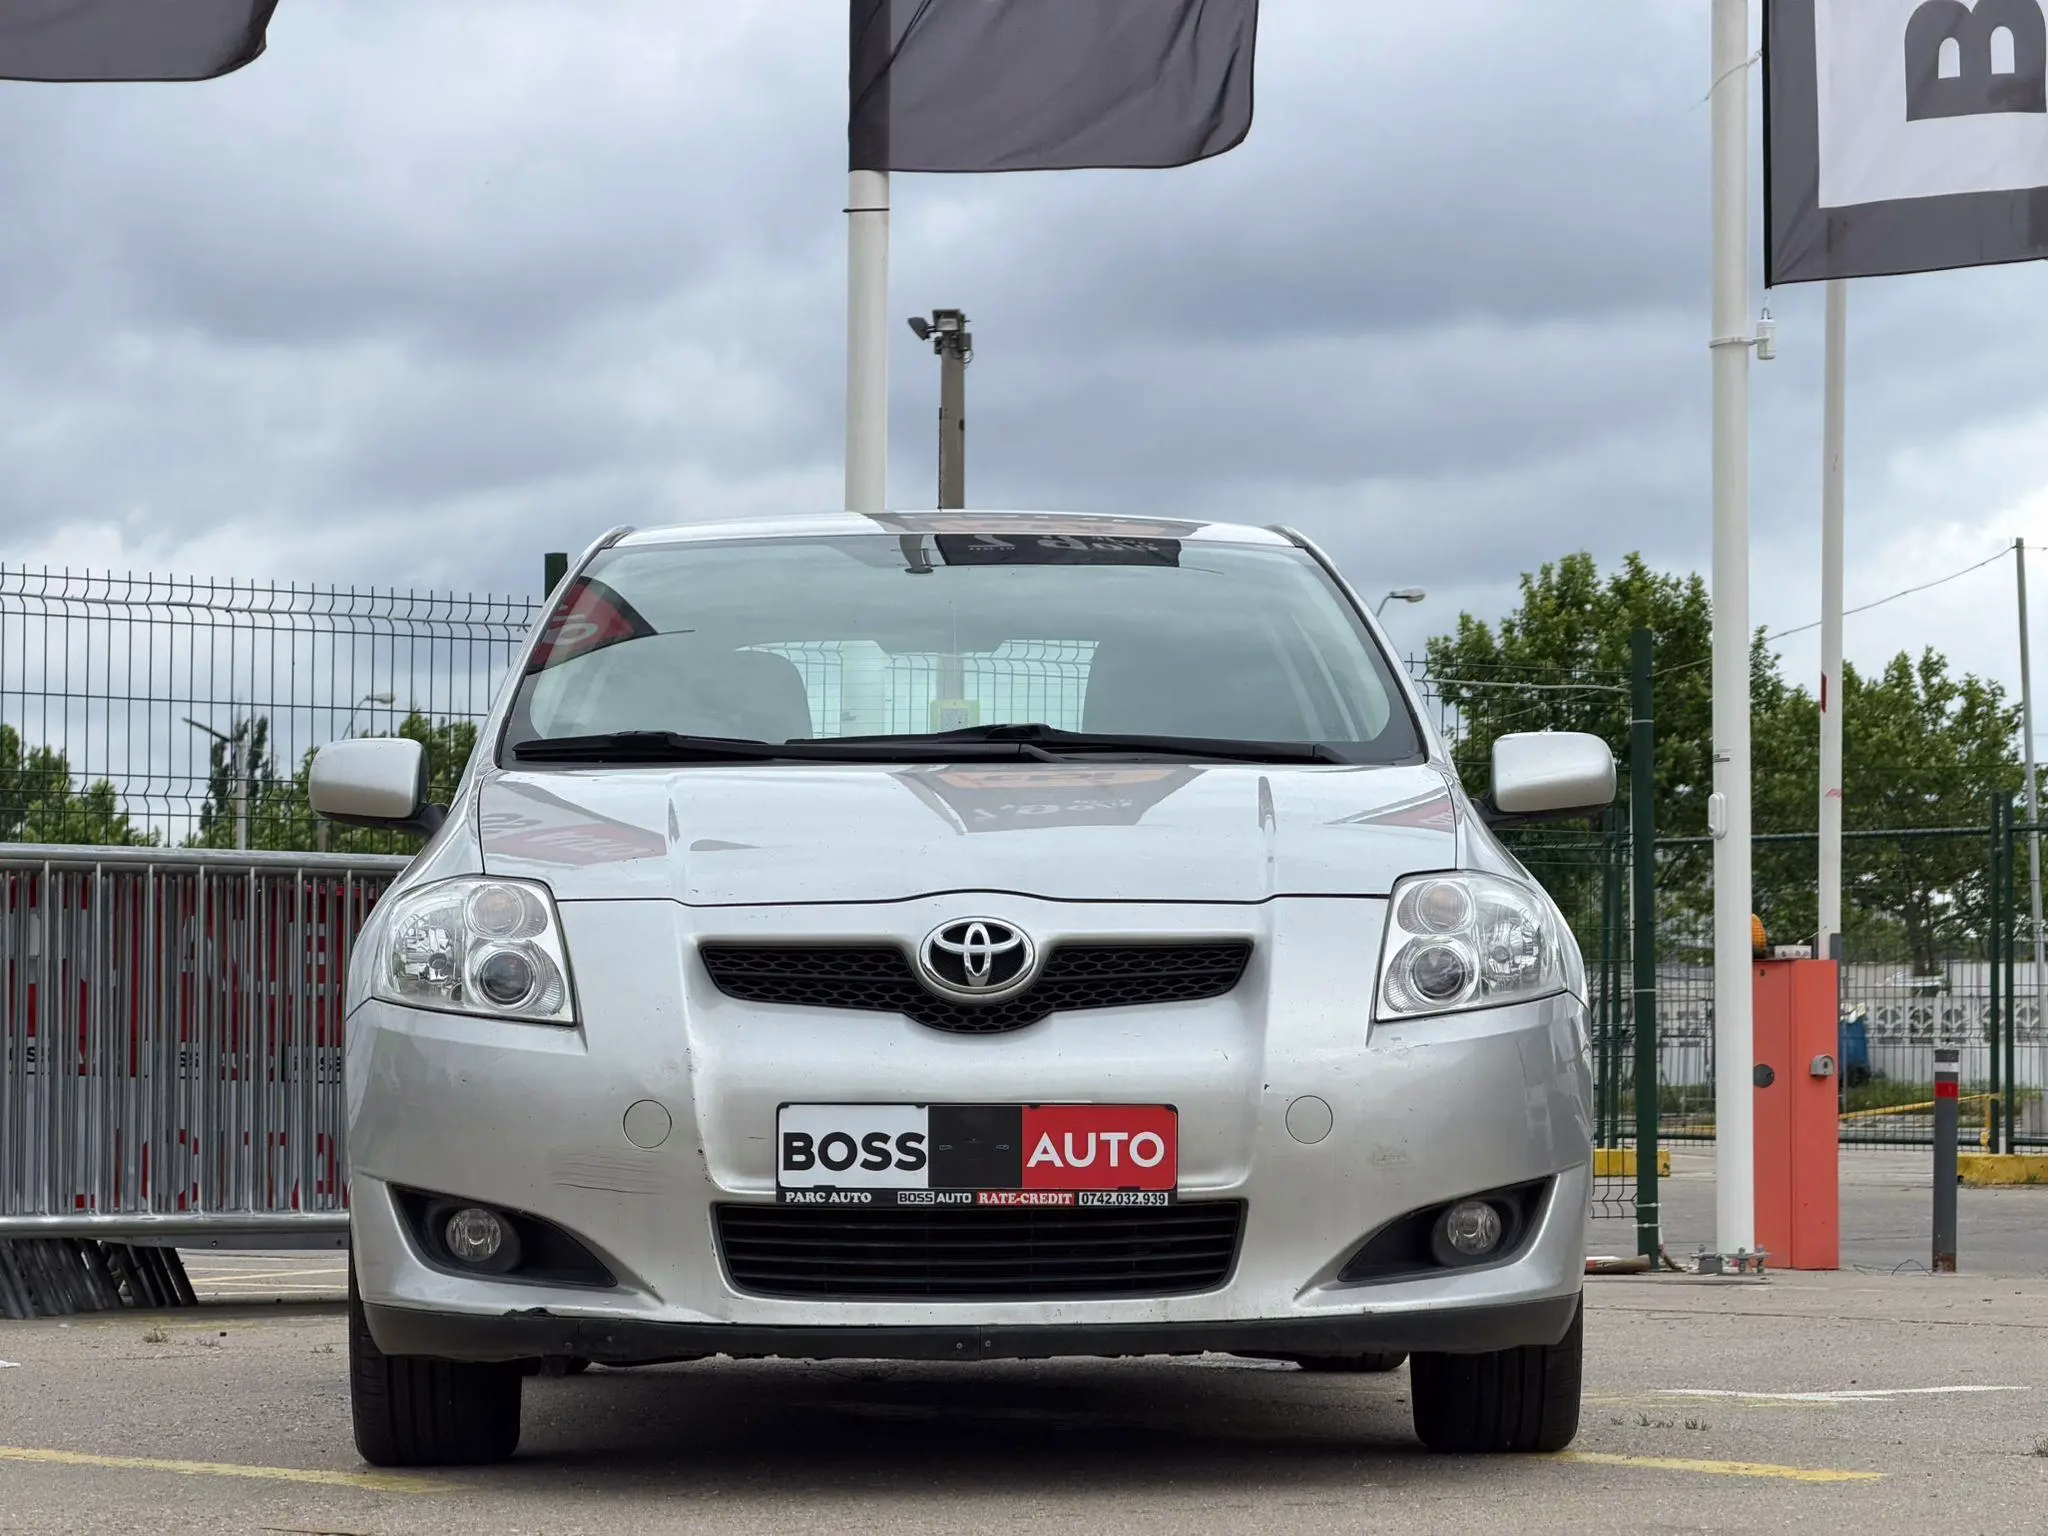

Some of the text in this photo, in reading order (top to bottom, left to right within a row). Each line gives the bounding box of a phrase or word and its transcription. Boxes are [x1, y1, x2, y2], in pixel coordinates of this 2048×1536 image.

[783, 1132, 1164, 1171] BOSS AUTO
[785, 1192, 1166, 1205] PARC AUTO BOSS AUTO RATE-CREDIT 0742.032.939
